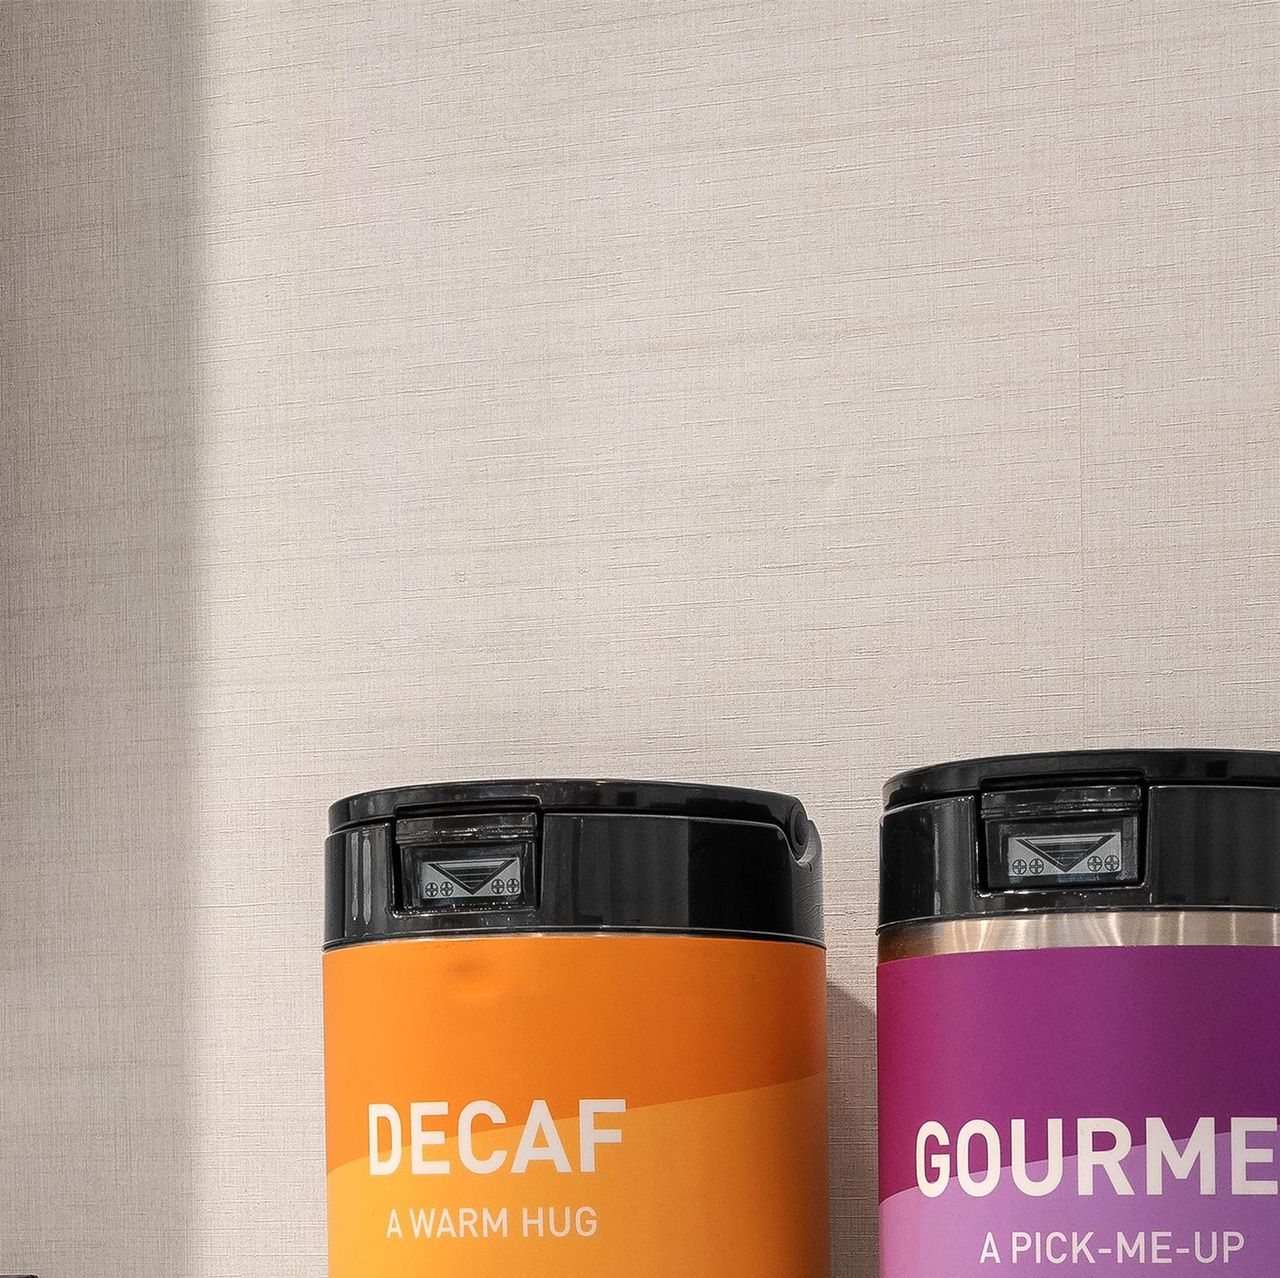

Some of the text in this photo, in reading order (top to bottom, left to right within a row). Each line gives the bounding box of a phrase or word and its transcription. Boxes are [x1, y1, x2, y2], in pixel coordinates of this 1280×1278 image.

[367, 1098, 626, 1177] DECAF
[386, 1205, 599, 1239] A WARM HUG
[979, 1230, 1246, 1264] A PICK-ME-UP
